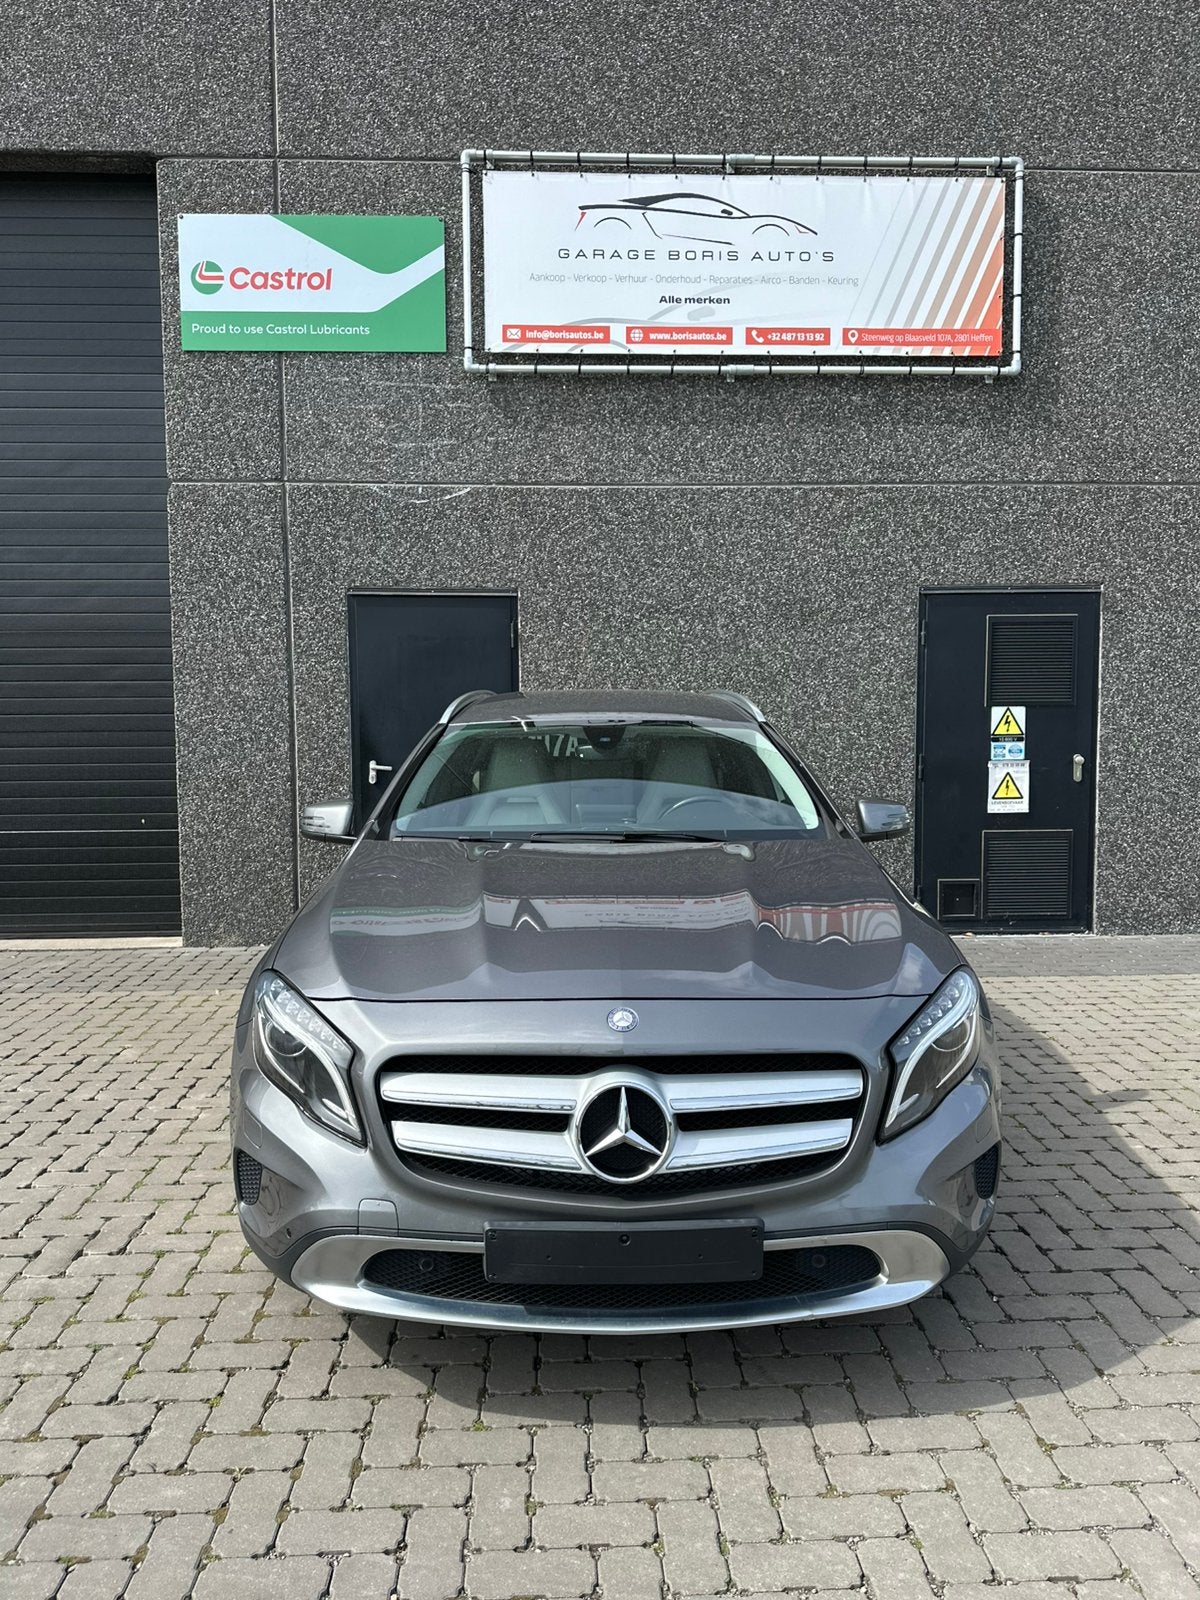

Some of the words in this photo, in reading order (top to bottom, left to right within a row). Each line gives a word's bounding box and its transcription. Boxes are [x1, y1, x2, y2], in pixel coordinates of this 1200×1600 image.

[558, 249, 655, 260] GARAGE
[669, 250, 738, 261] BORIS
[751, 251, 833, 262] AUTO'S
[229, 267, 332, 290] Castrol
[529, 273, 565, 283] Aankoop
[574, 273, 607, 284] Verkoop
[615, 274, 647, 283] Verhuur
[656, 274, 701, 284] Onderhoud
[709, 275, 752, 285] Reparaties
[760, 275, 781, 285] Airco
[789, 276, 820, 285] Banden
[828, 276, 859, 287] Keuring
[659, 296, 682, 304] Alle
[685, 296, 730, 304] merken
[192, 324, 225, 333] Proud
[229, 325, 241, 333] to
[266, 323, 306, 335] Castrol
[310, 325, 370, 334] Lubricants
[526, 330, 604, 340] info@borisautos.be
[649, 331, 727, 341] www.borisautos.be
[767, 332, 781, 341] +32
[781, 332, 796, 341] 487
[797, 332, 805, 341] 13
[806, 332, 814, 341] 13
[815, 332, 825, 342] 92
[861, 333, 894, 343] Steenweg
[895, 334, 904, 342] op
[905, 333, 936, 342] Blaasveld
[971, 334, 993, 342] Heffen
